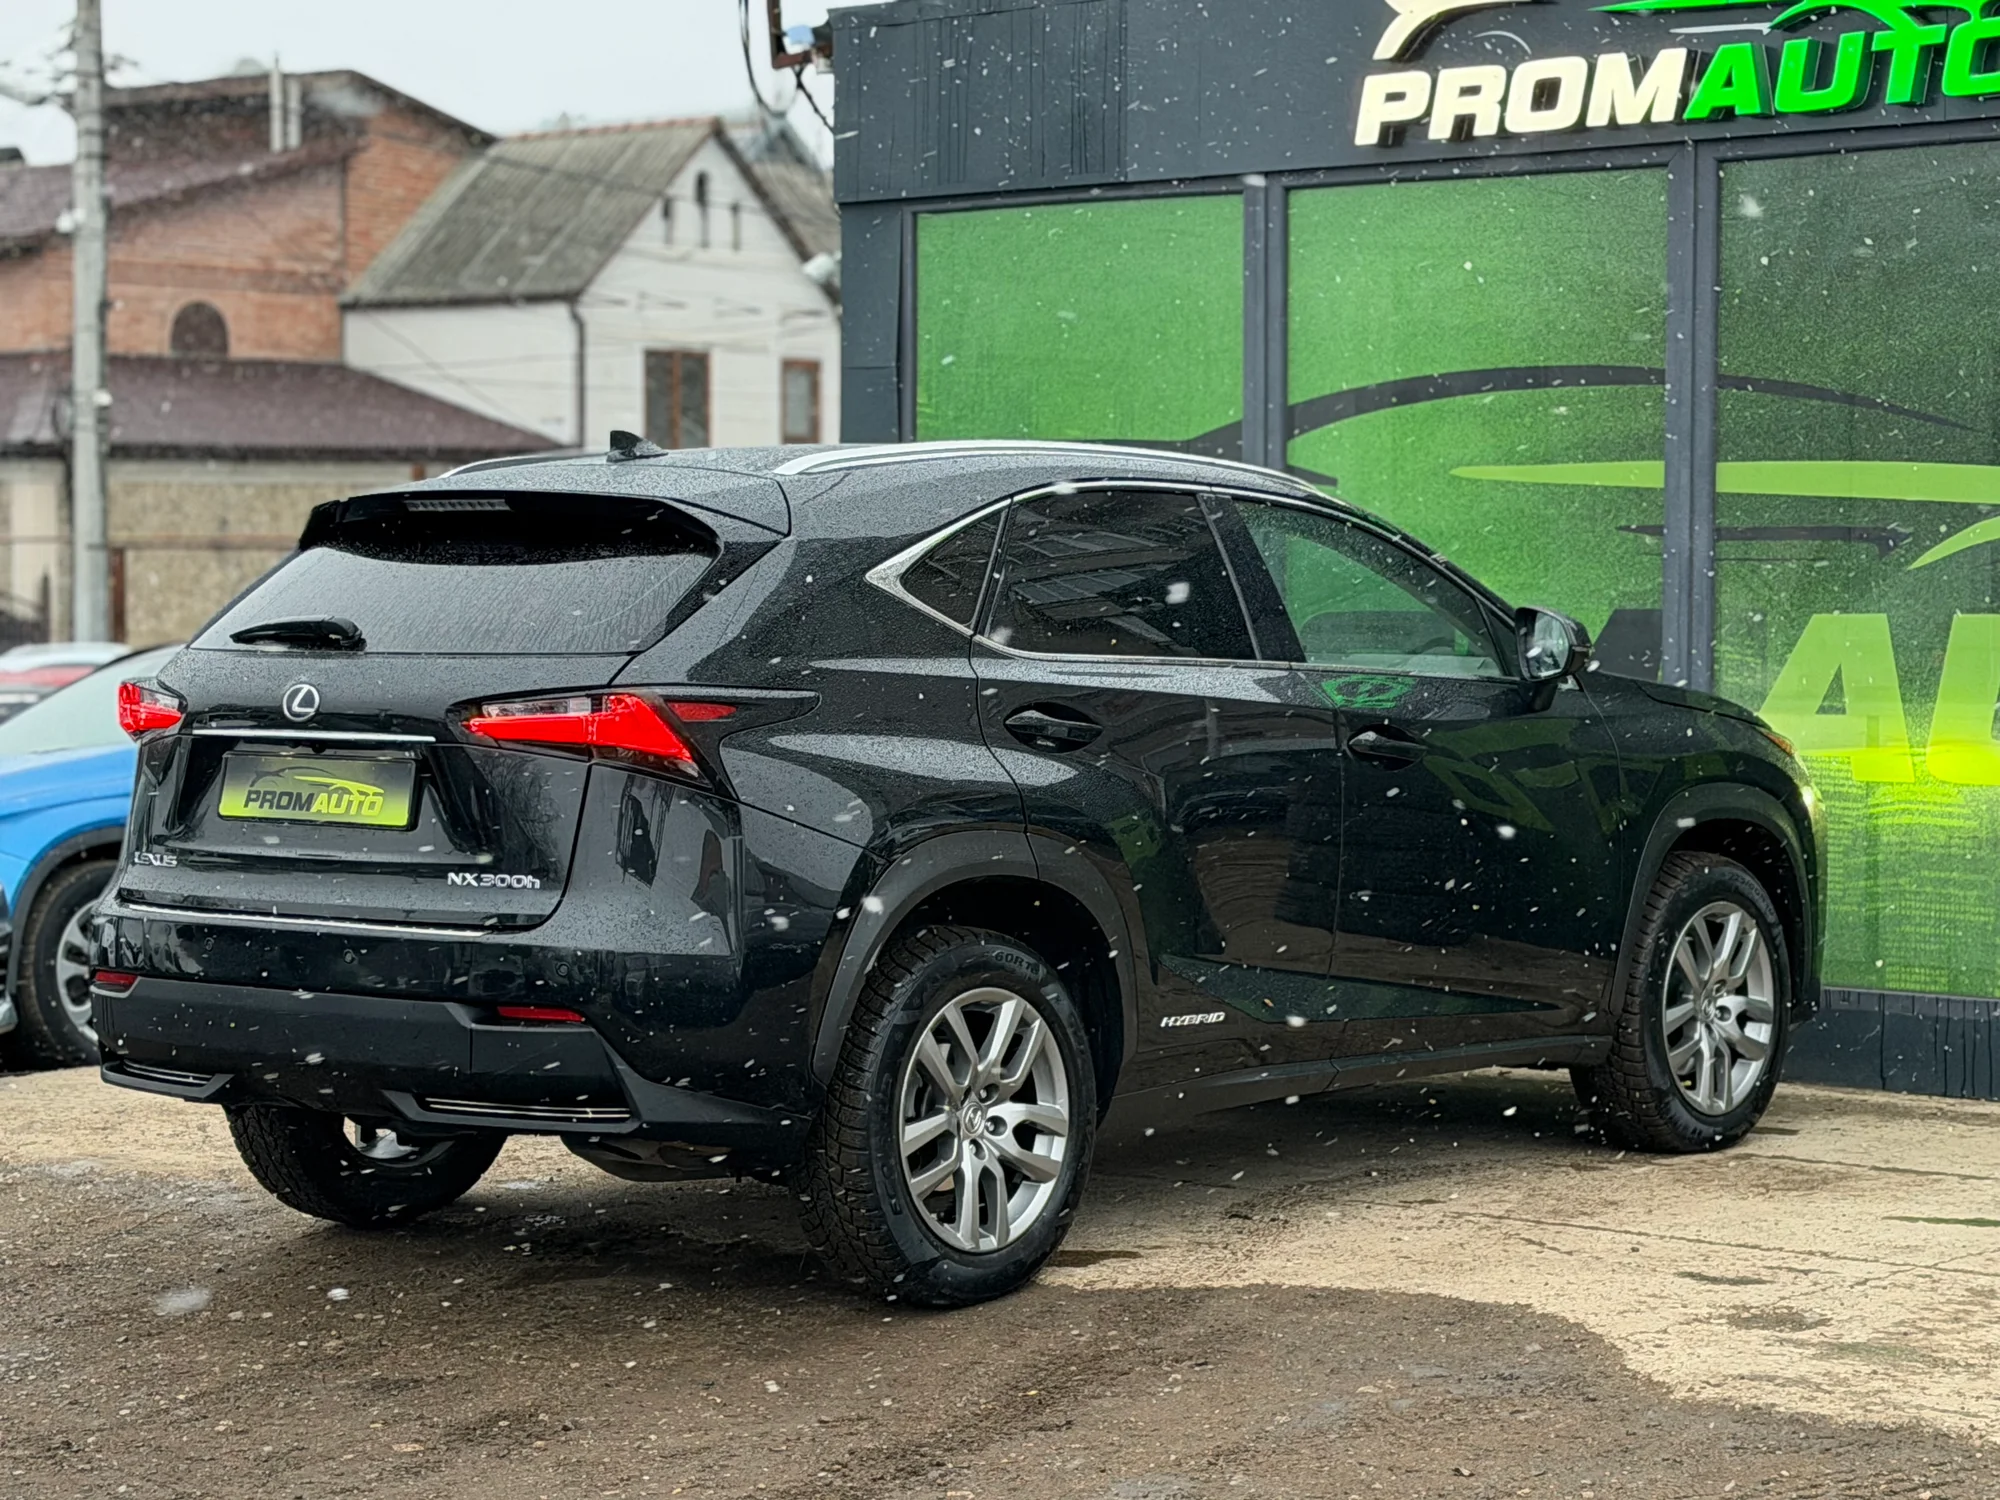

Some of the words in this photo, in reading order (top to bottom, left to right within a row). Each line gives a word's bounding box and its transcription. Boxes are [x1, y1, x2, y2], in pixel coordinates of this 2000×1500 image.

[1355, 17, 2000, 147] PROMAUTO
[243, 788, 384, 816] PROMAUTO
[1160, 1011, 1226, 1028] HYBRID
